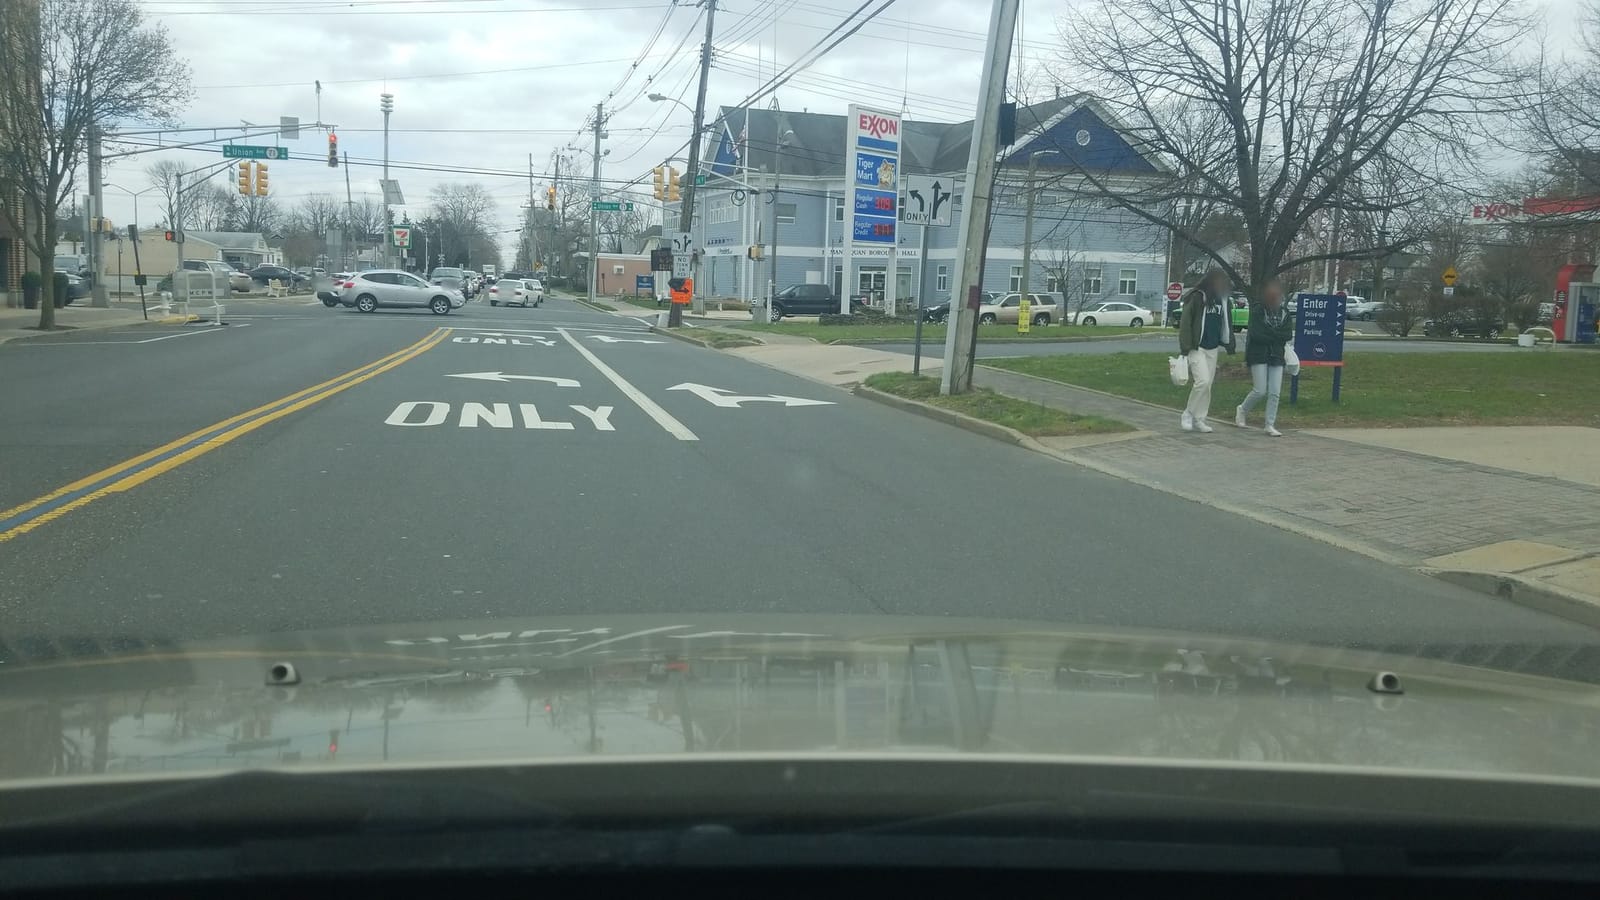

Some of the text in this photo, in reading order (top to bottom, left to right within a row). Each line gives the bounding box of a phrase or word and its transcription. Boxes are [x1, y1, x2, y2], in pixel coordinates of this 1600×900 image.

[860, 113, 898, 139] EXXON
[232, 148, 254, 157] Union
[858, 157, 874, 170] Tiger
[857, 169, 873, 181] Mart
[856, 193, 874, 203] Regular
[906, 212, 929, 221] ONLY
[855, 221, 873, 231] Regular
[855, 229, 869, 237] Credit
[1303, 298, 1328, 309] Enter
[1303, 328, 1322, 336] Parking
[452, 336, 558, 347] ONLY
[384, 401, 617, 431] ONLY
